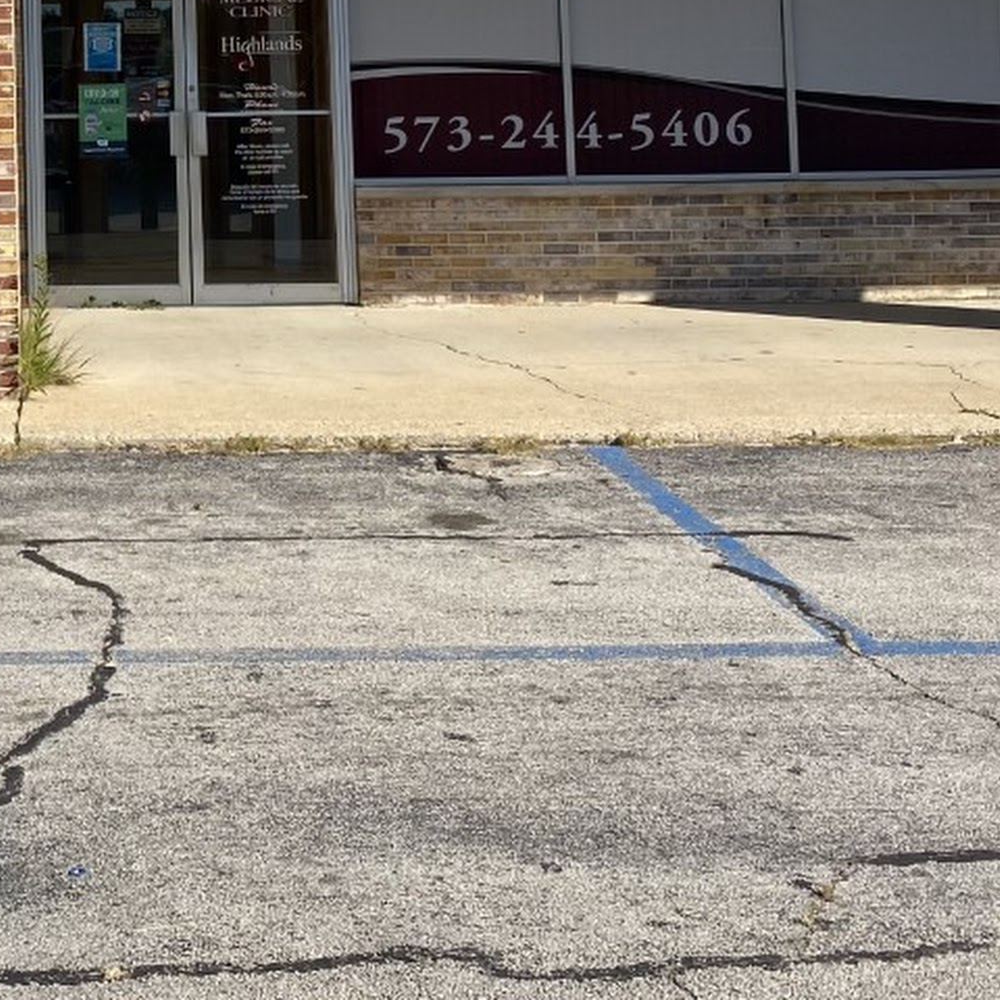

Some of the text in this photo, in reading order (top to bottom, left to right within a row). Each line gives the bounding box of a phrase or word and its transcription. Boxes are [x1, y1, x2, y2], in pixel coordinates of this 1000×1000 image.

[229, 5, 294, 18] CLINIC
[221, 34, 303, 67] Highlands
[382, 108, 753, 154] 573-244-5406
